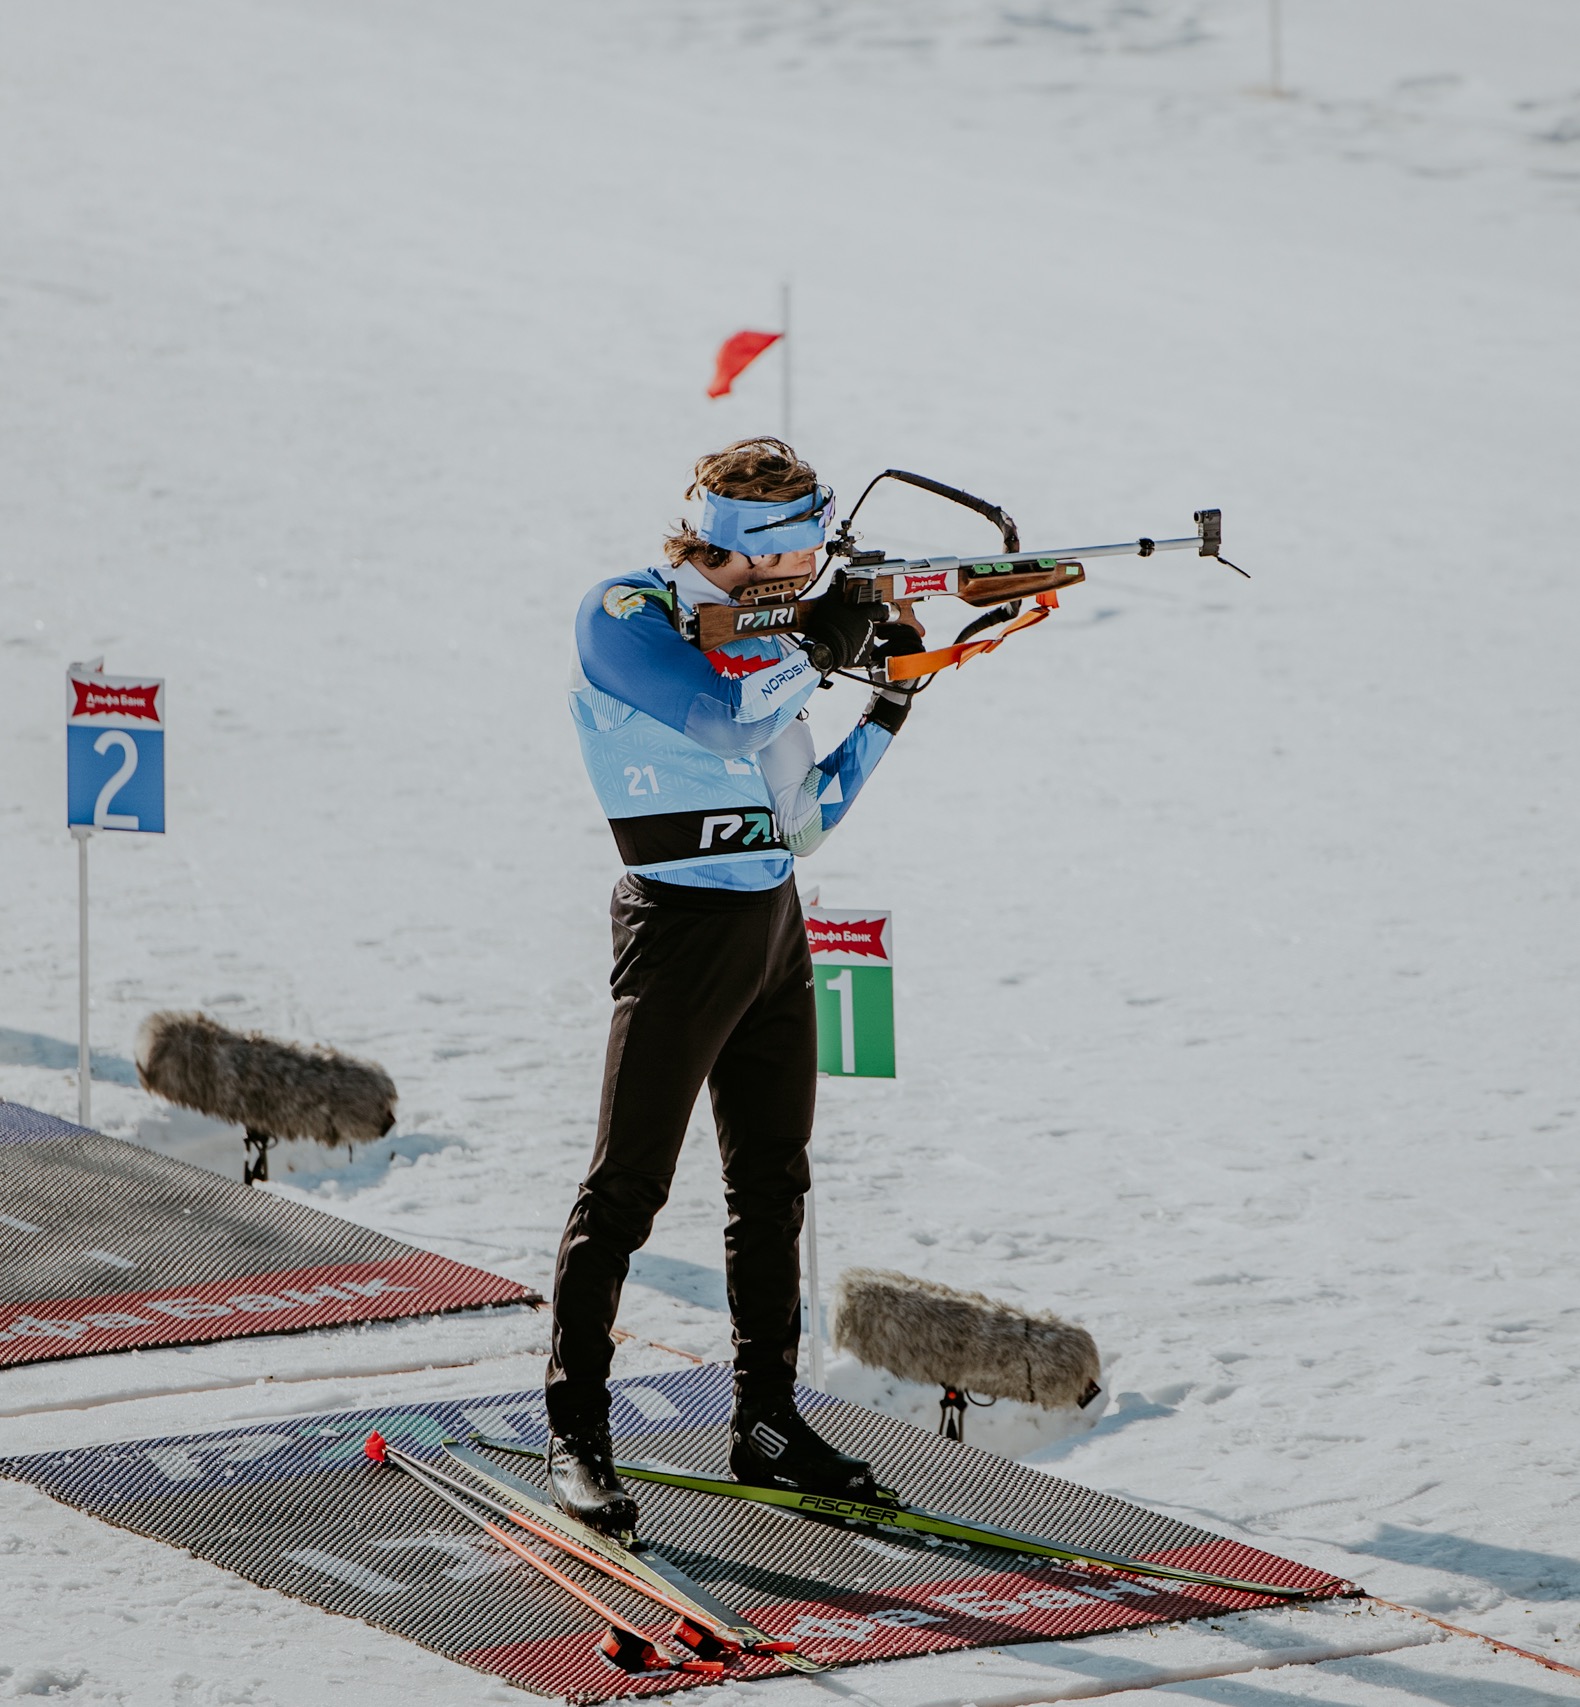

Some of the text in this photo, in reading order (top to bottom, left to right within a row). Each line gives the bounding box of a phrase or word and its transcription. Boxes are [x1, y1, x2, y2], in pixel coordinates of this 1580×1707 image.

[736, 606, 795, 631] PARI
[86, 692, 146, 708] Альфа Банк
[93, 729, 140, 831] 2
[623, 764, 660, 797] 21
[806, 929, 872, 944] Альфа Банк
[826, 968, 855, 1074] 1
[799, 1495, 898, 1524] FISCHER
